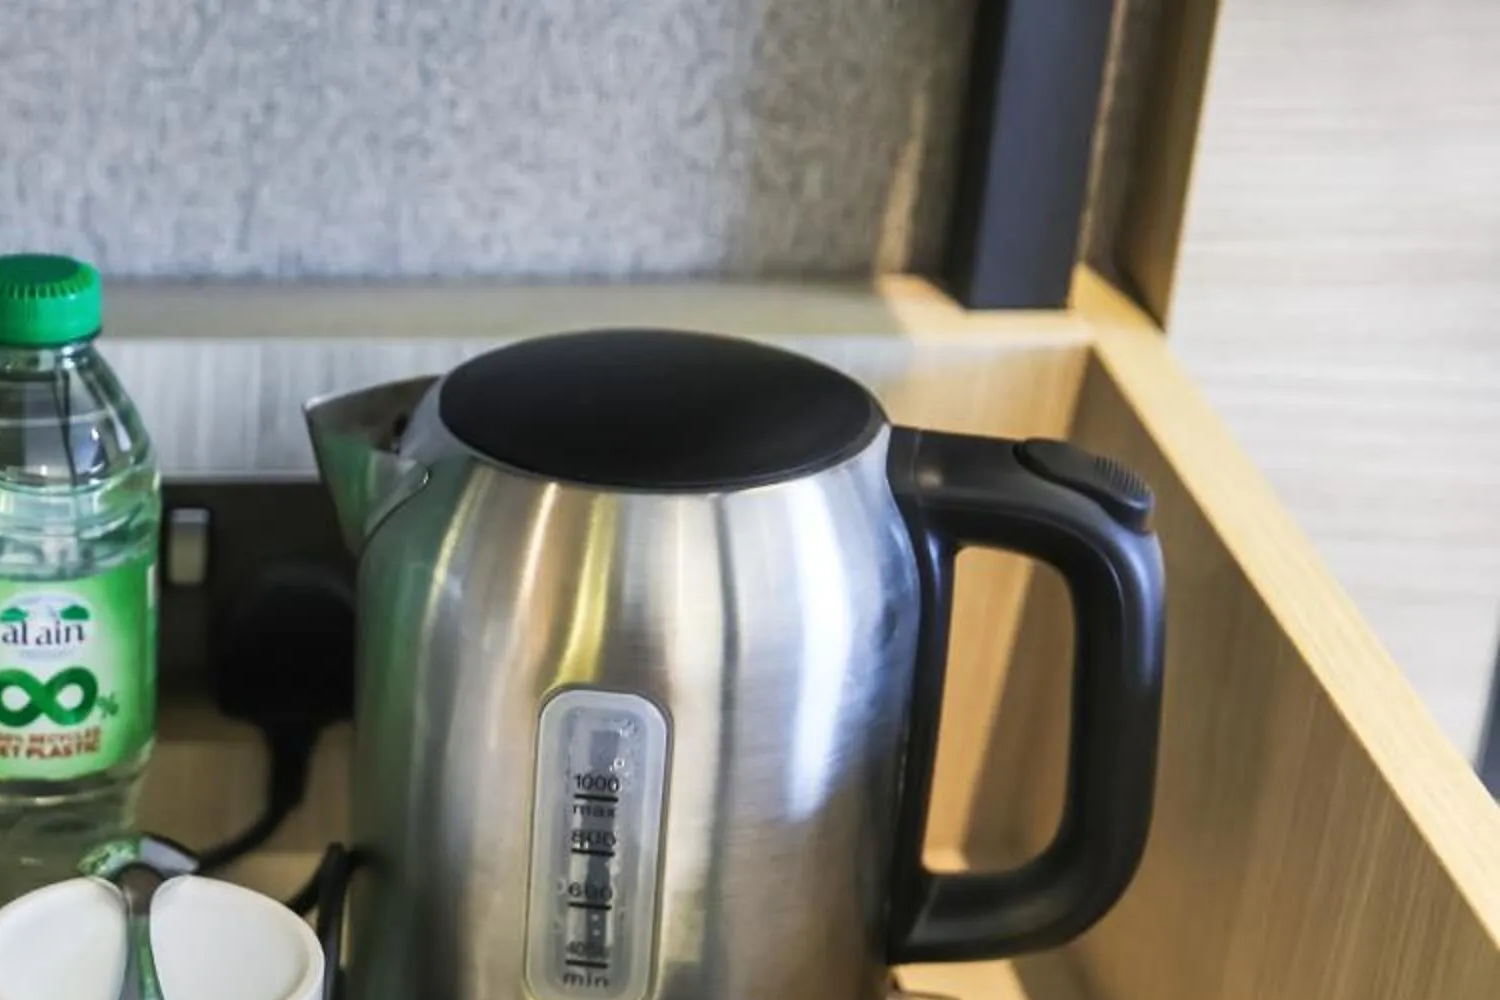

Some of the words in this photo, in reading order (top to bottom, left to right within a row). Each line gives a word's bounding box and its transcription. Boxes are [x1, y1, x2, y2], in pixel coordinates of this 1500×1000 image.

[573, 774, 620, 793] 1000
[573, 803, 616, 819] max
[568, 881, 613, 901] 600
[562, 972, 610, 989] min
